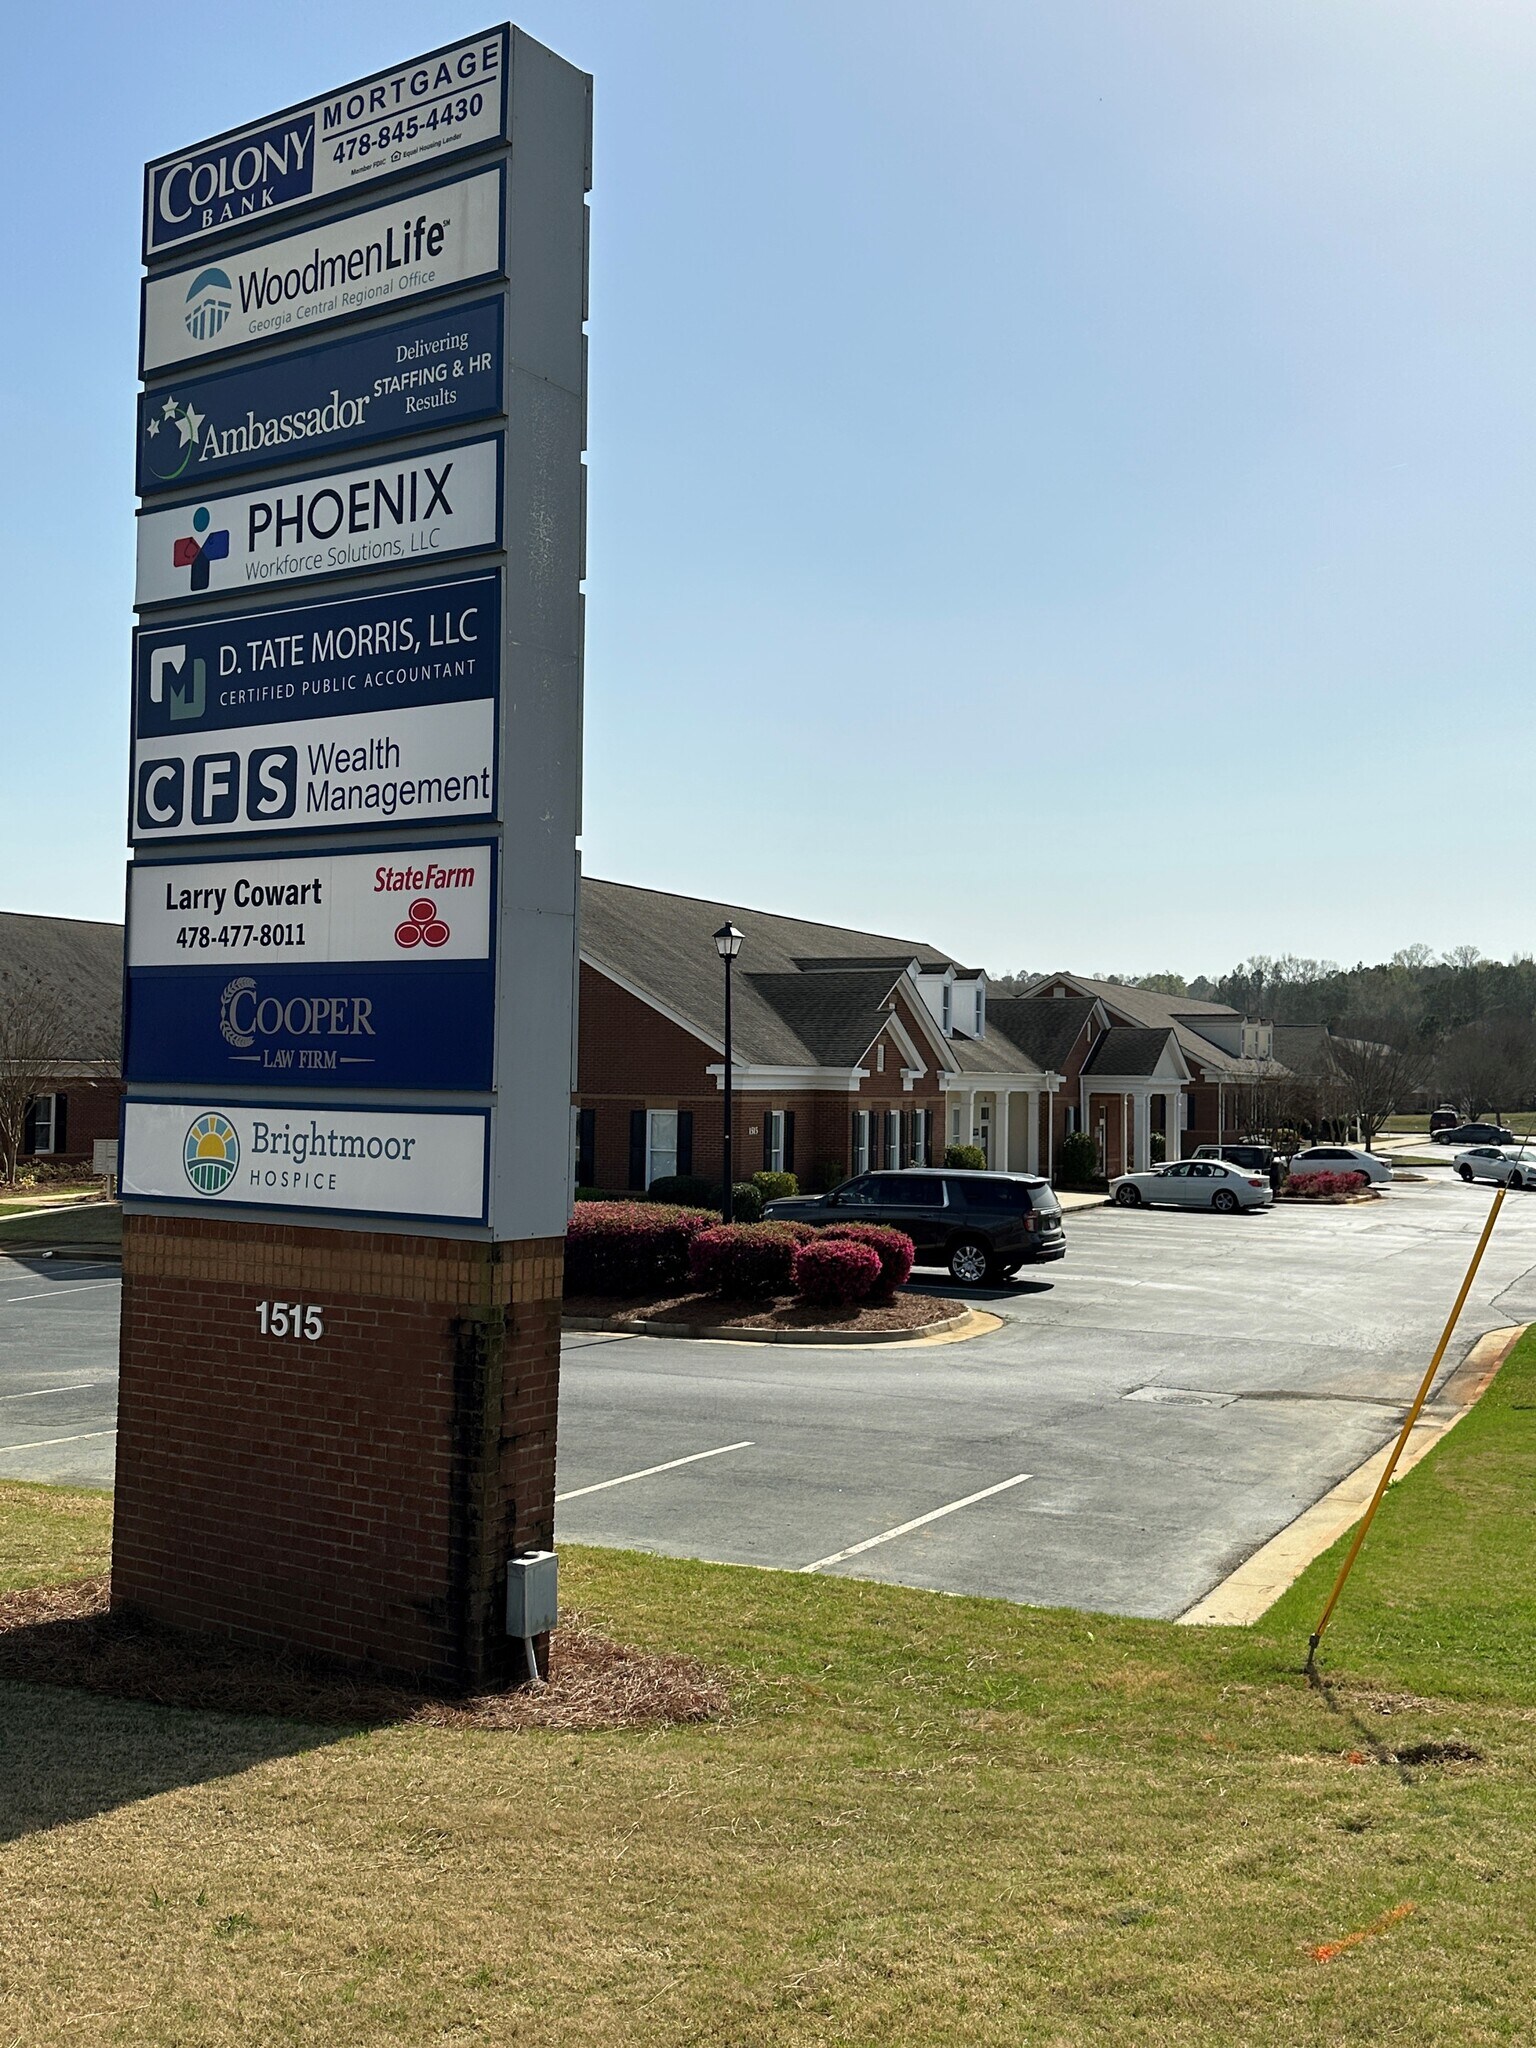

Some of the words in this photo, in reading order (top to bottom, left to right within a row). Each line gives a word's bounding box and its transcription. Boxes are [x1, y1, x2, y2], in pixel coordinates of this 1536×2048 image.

[322, 42, 499, 130] MORTGAGE
[332, 93, 484, 164] 478-845-4430
[403, 148, 418, 158] Equal
[420, 140, 442, 152] Housing
[442, 133, 462, 145] Lender
[159, 124, 314, 224] COLONY
[350, 164, 373, 175] Member
[373, 158, 386, 169] FDIC
[202, 186, 275, 228] BANK
[238, 215, 445, 314] WoodmenLife
[248, 311, 292, 334] Georgia
[296, 291, 338, 320] Central
[341, 279, 394, 308] Regional
[399, 269, 435, 290] Office
[396, 332, 469, 363] Delivering
[373, 363, 447, 397] STAFFING
[452, 358, 465, 377] &
[469, 352, 492, 374] HR
[405, 387, 457, 414] Results
[198, 390, 371, 463] Ambassador
[249, 463, 454, 552] PHOENIX
[245, 551, 323, 581] Workforce
[327, 539, 406, 568] Solutions,
[410, 528, 441, 552] LLC
[219, 645, 242, 677] D.
[247, 634, 304, 672] TATE
[312, 617, 421, 663] MORRIS,
[429, 608, 478, 647] LLC
[220, 682, 295, 706] CERTIFIED
[302, 675, 356, 696] PUBLIC
[364, 659, 476, 688] ACCOUNTANT
[307, 737, 400, 776] Wealth
[306, 766, 490, 815] Management
[166, 882, 226, 915] Larry
[233, 878, 322, 908] Cowart
[176, 923, 306, 949] 478-477-8011
[229, 989, 376, 1036] COOPER
[263, 1050, 294, 1069] LAW
[298, 1050, 337, 1069] FIRM
[251, 1121, 416, 1164] Brightmoor
[250, 1170, 337, 1190] HOSPICE
[256, 1301, 324, 1340] 1515
